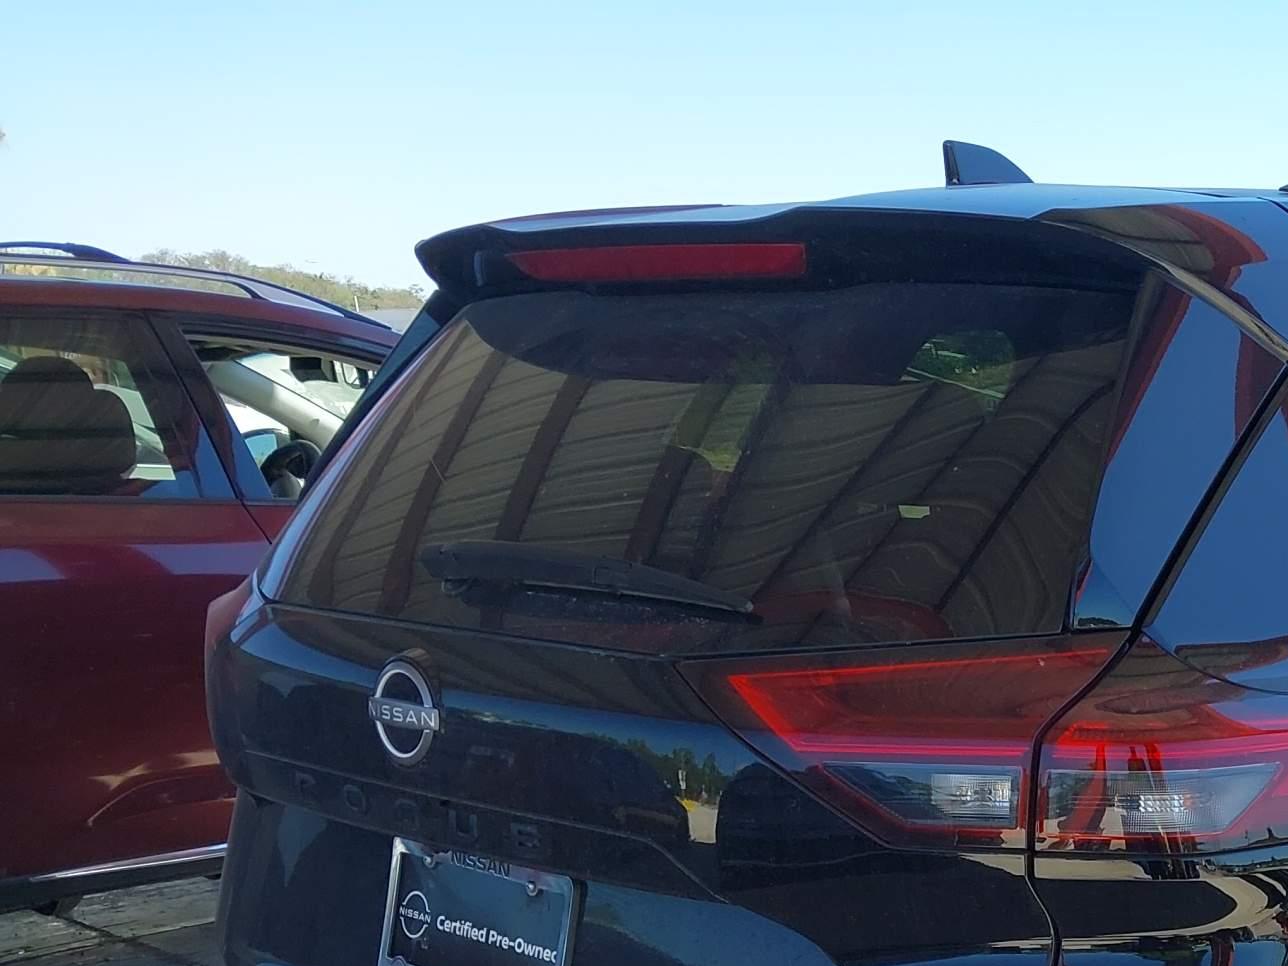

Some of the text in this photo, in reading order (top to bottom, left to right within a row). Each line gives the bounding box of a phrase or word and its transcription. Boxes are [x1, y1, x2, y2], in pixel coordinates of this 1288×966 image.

[368, 699, 435, 727] NISSAN
[450, 850, 512, 879] NISSAN
[399, 906, 432, 924] NISSAN
[436, 915, 486, 943] Certified
